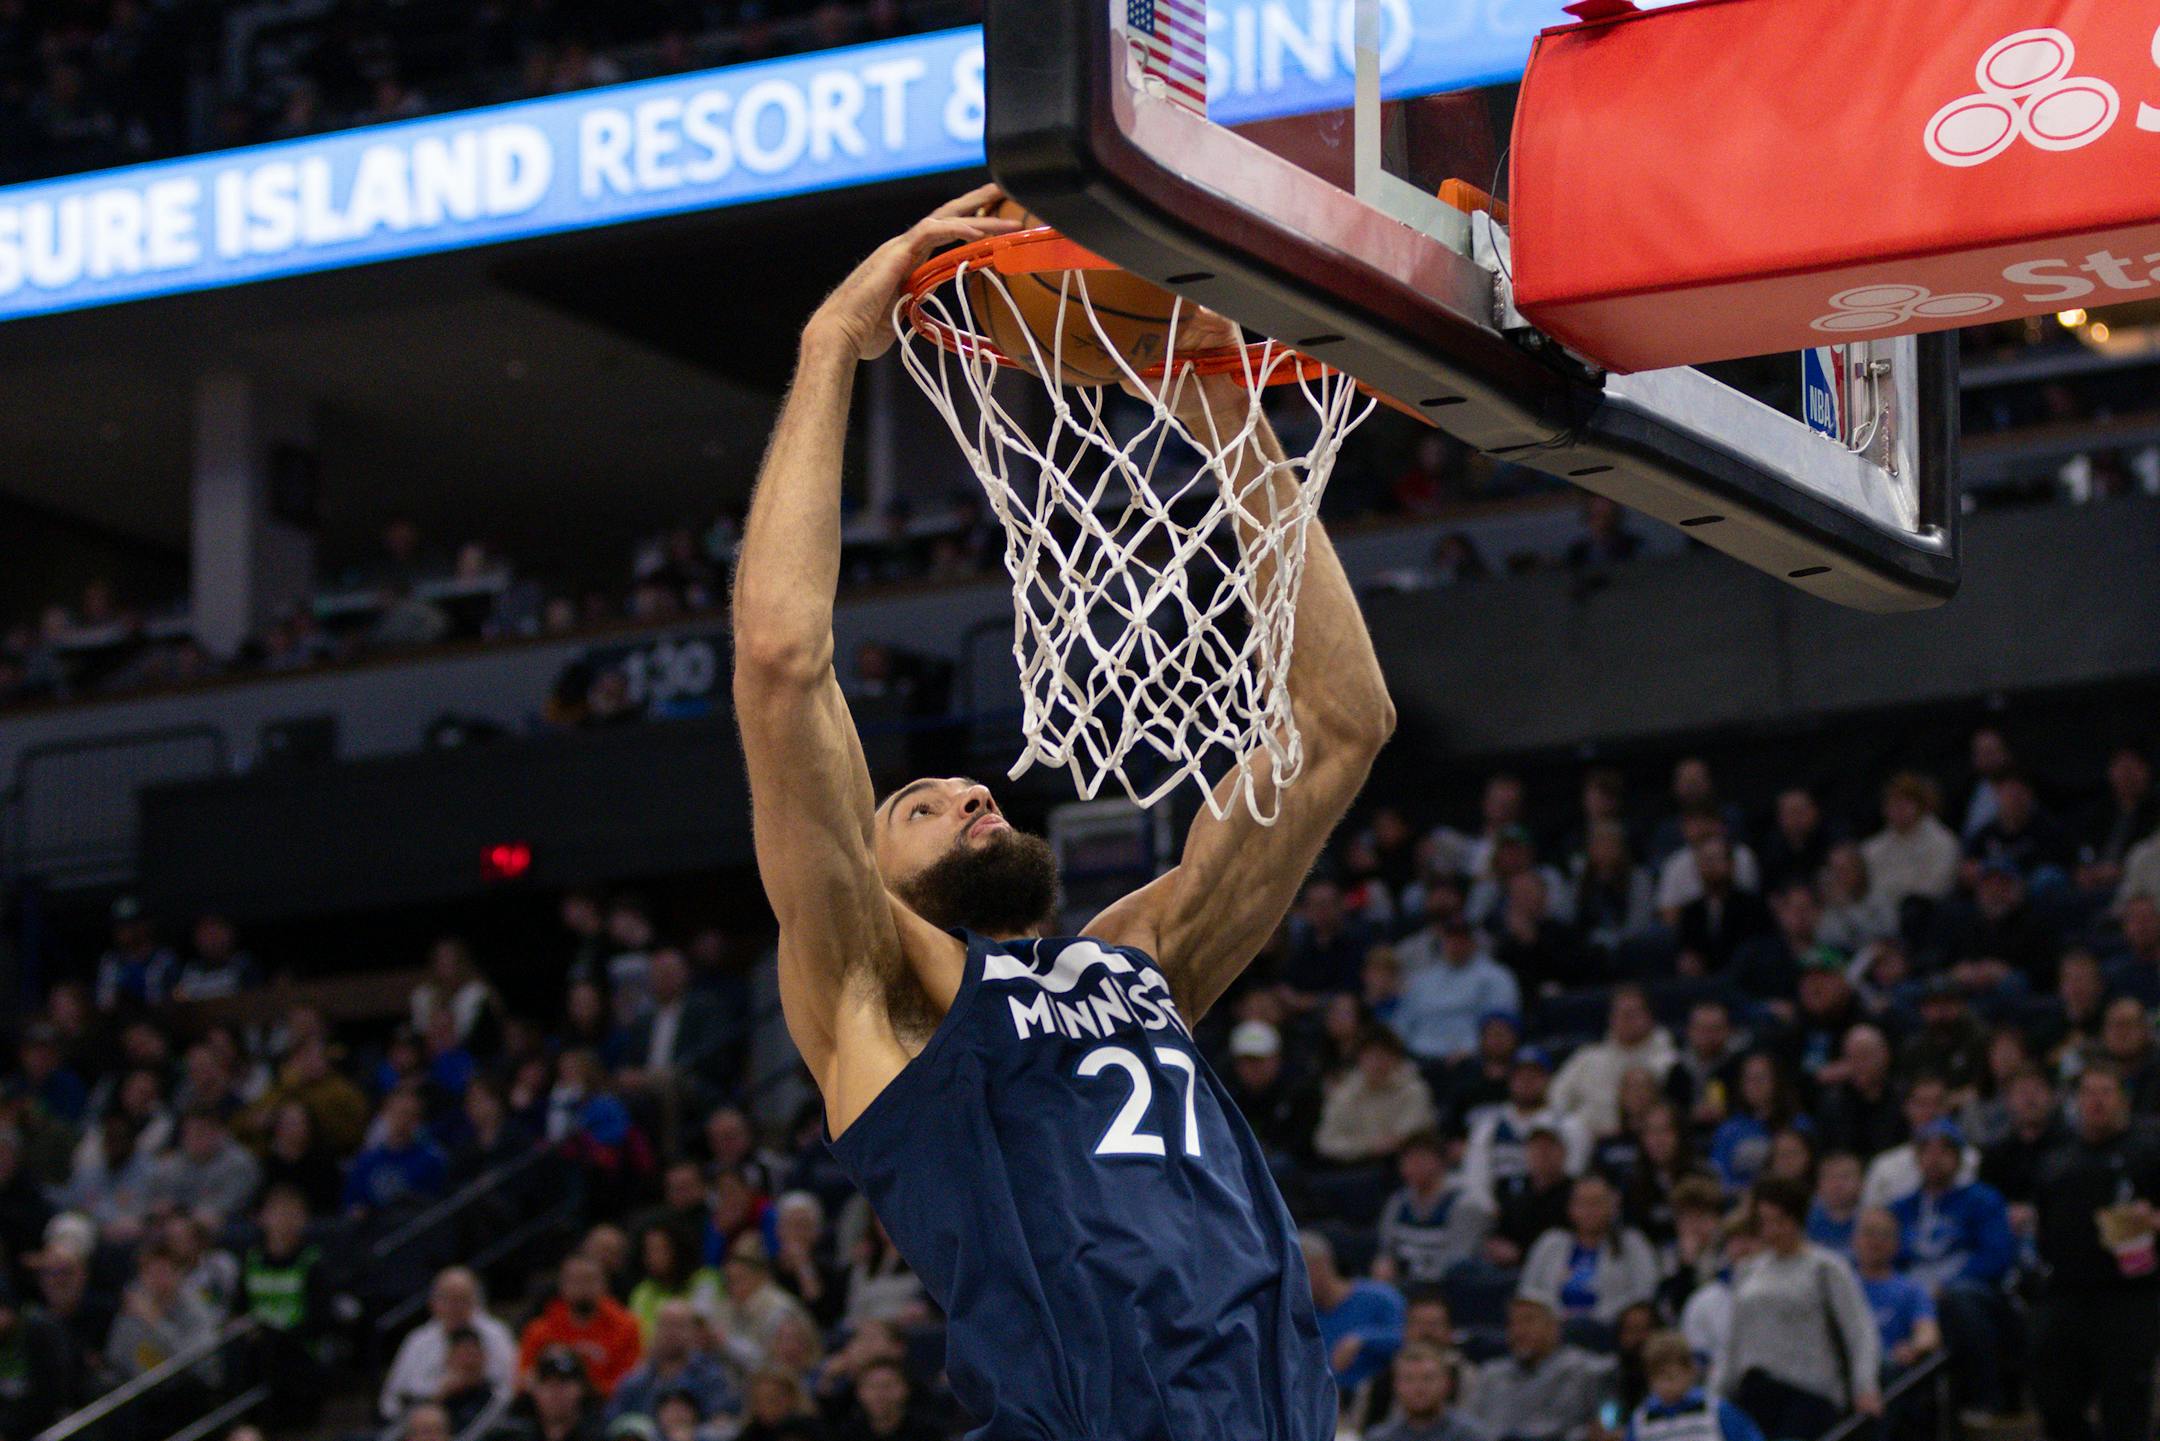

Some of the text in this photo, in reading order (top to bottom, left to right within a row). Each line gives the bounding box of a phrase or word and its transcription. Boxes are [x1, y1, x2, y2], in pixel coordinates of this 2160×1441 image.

[214, 124, 552, 259] ISLAND
[579, 57, 925, 196] RESORT
[1809, 384, 1833, 429] NBA
[1076, 1046, 1201, 1156] 27
